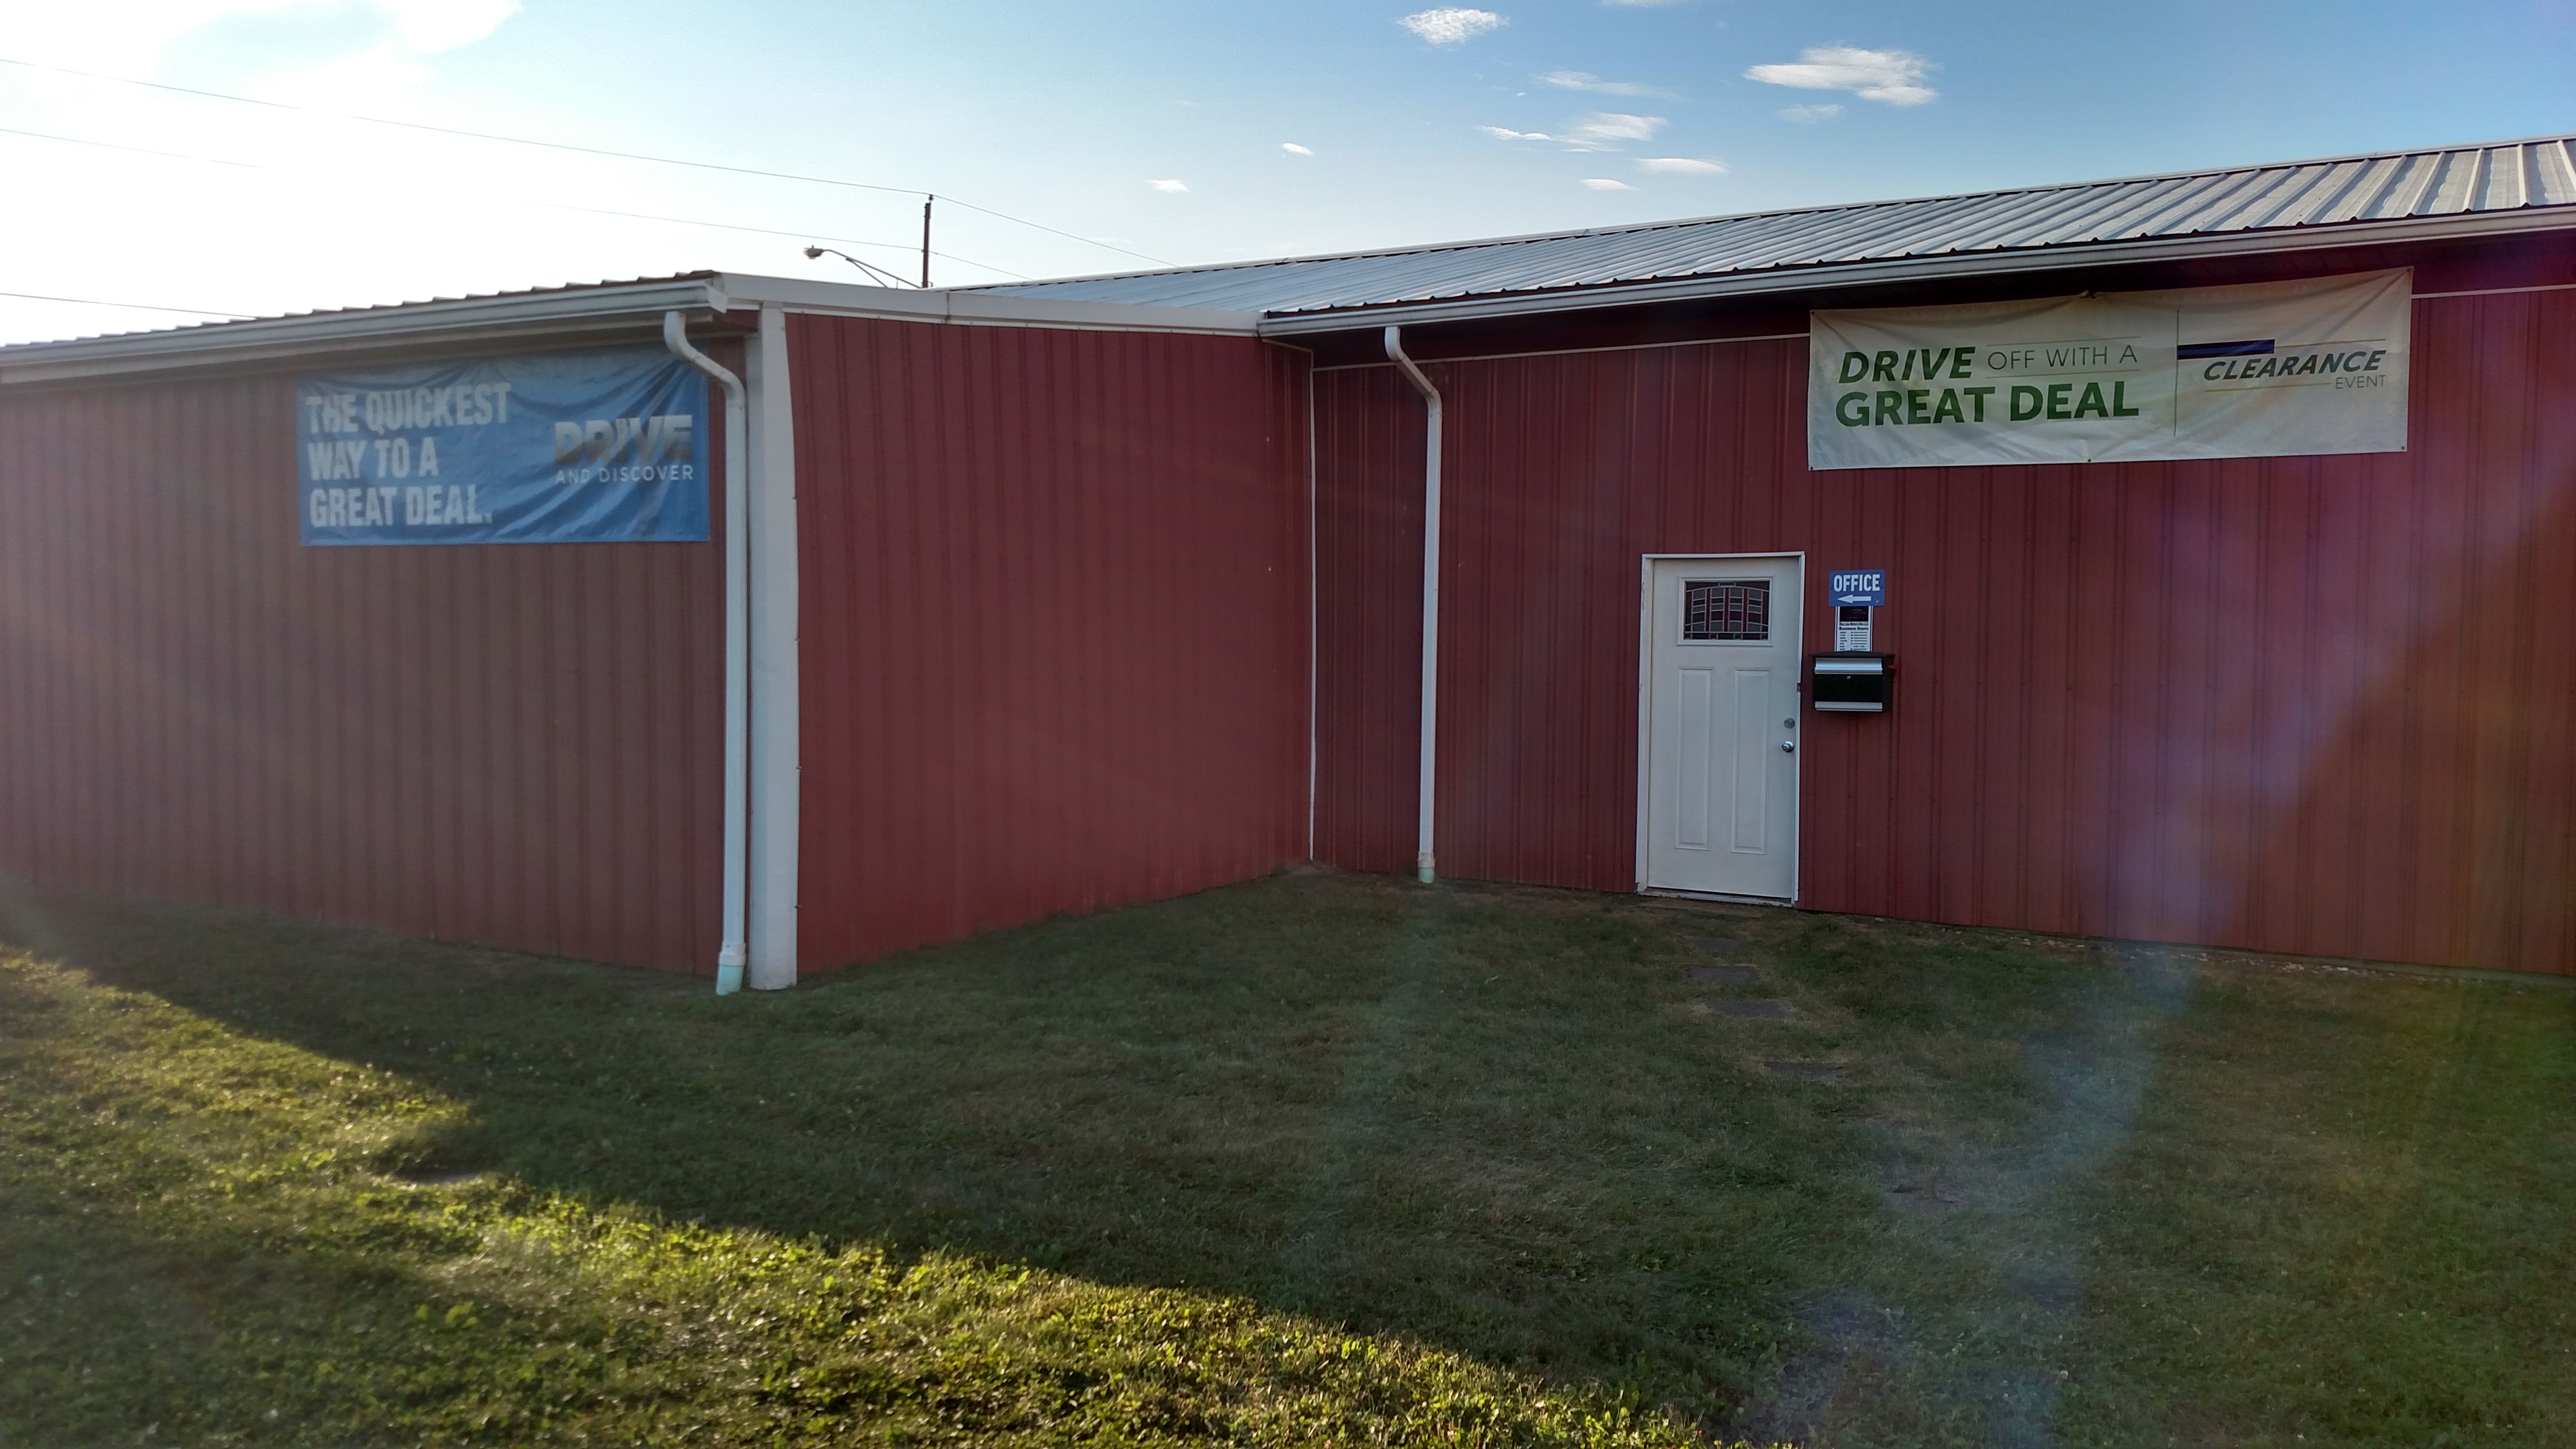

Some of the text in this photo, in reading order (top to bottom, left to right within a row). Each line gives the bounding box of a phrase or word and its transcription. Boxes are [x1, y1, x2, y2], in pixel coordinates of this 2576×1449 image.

[1838, 345, 2138, 383] DRIVE OFF WITH A
[2203, 349, 2387, 381] CLEARANCE
[2335, 375, 2387, 389] EVENT
[306, 382, 511, 434] THE QUICKEST
[1836, 381, 2139, 427] GREAT DEAL
[308, 436, 439, 481] WAY TO A
[555, 414, 693, 466] DRIVE
[555, 464, 694, 484] AND DISCOVER
[309, 483, 493, 528] GREAT DEAL.
[1834, 574, 1880, 592] OFFICE
